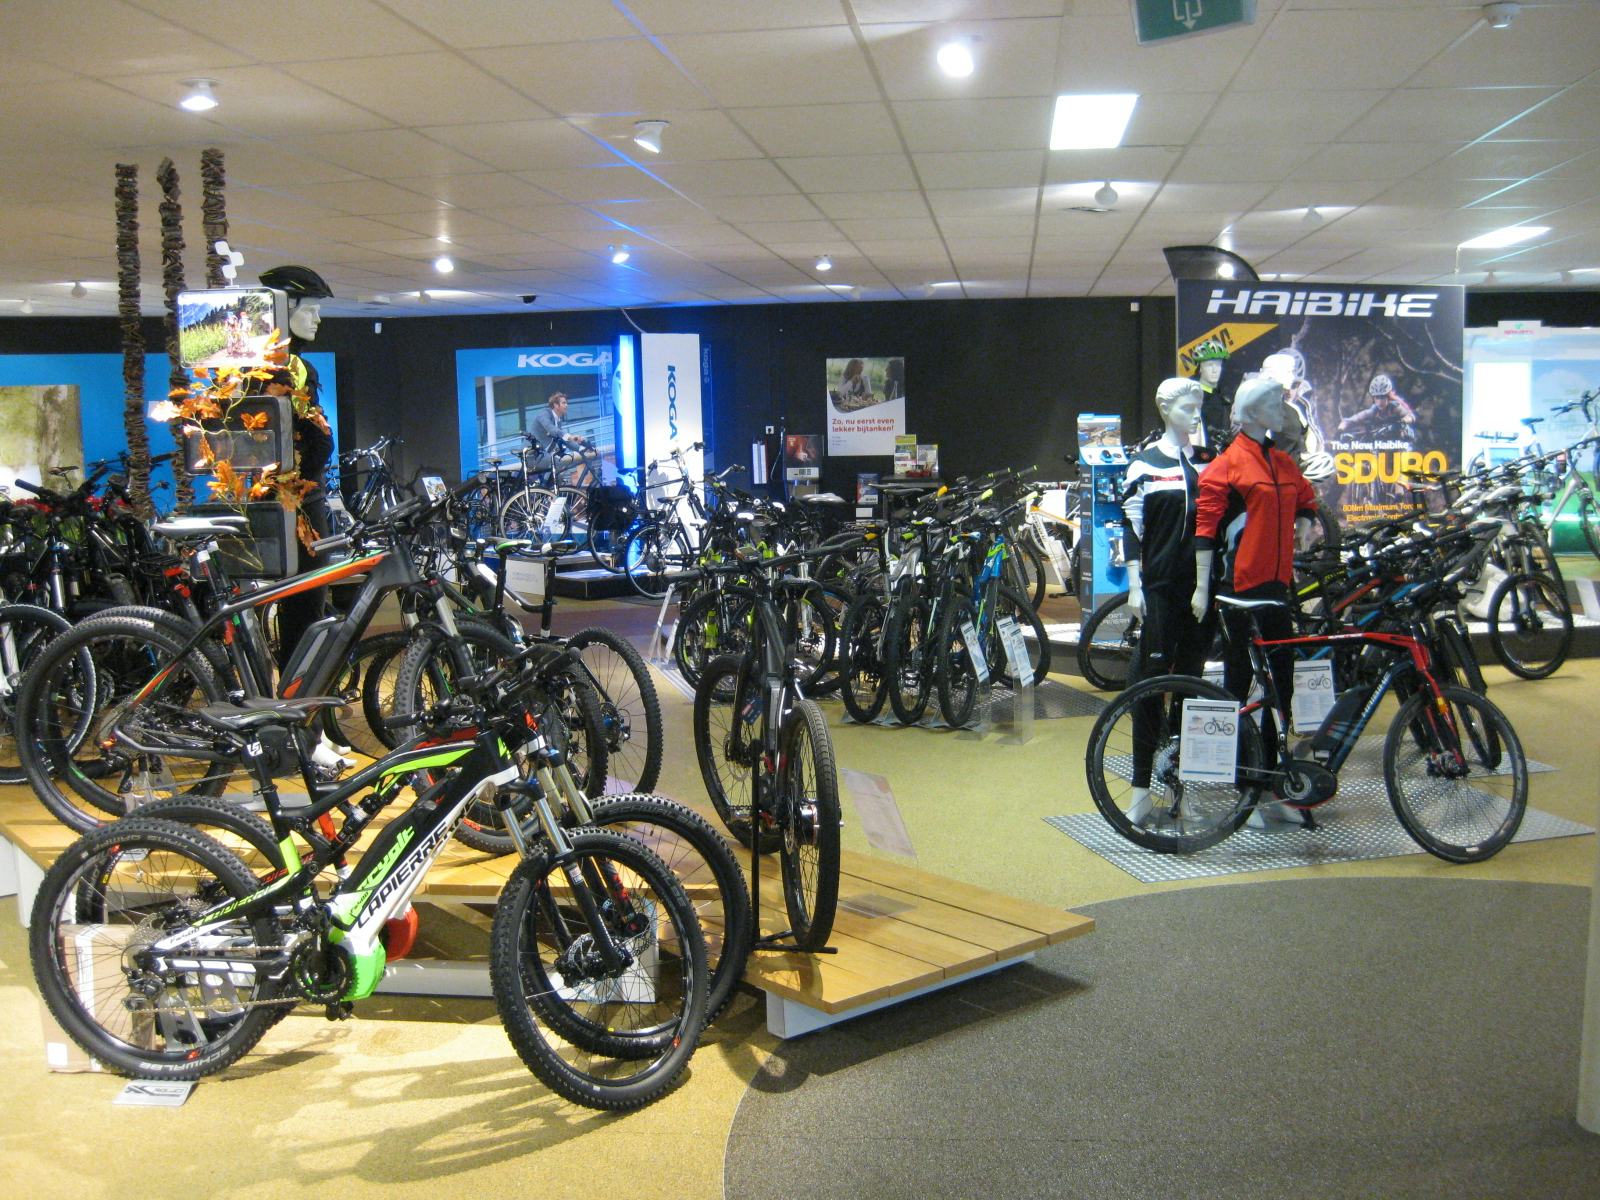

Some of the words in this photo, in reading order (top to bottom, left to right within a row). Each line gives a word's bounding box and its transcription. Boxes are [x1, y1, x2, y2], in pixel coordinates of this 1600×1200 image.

[518, 353, 612, 368] KOGA
[667, 365, 677, 440] KOGA
[832, 425, 855, 433] lekker
[857, 424, 894, 434] bijtanken!
[1330, 441, 1349, 450] The
[1374, 440, 1410, 451] Haibike
[357, 821, 448, 929] LAPIERRE
[138, 1044, 231, 1072] SCHWALBE
